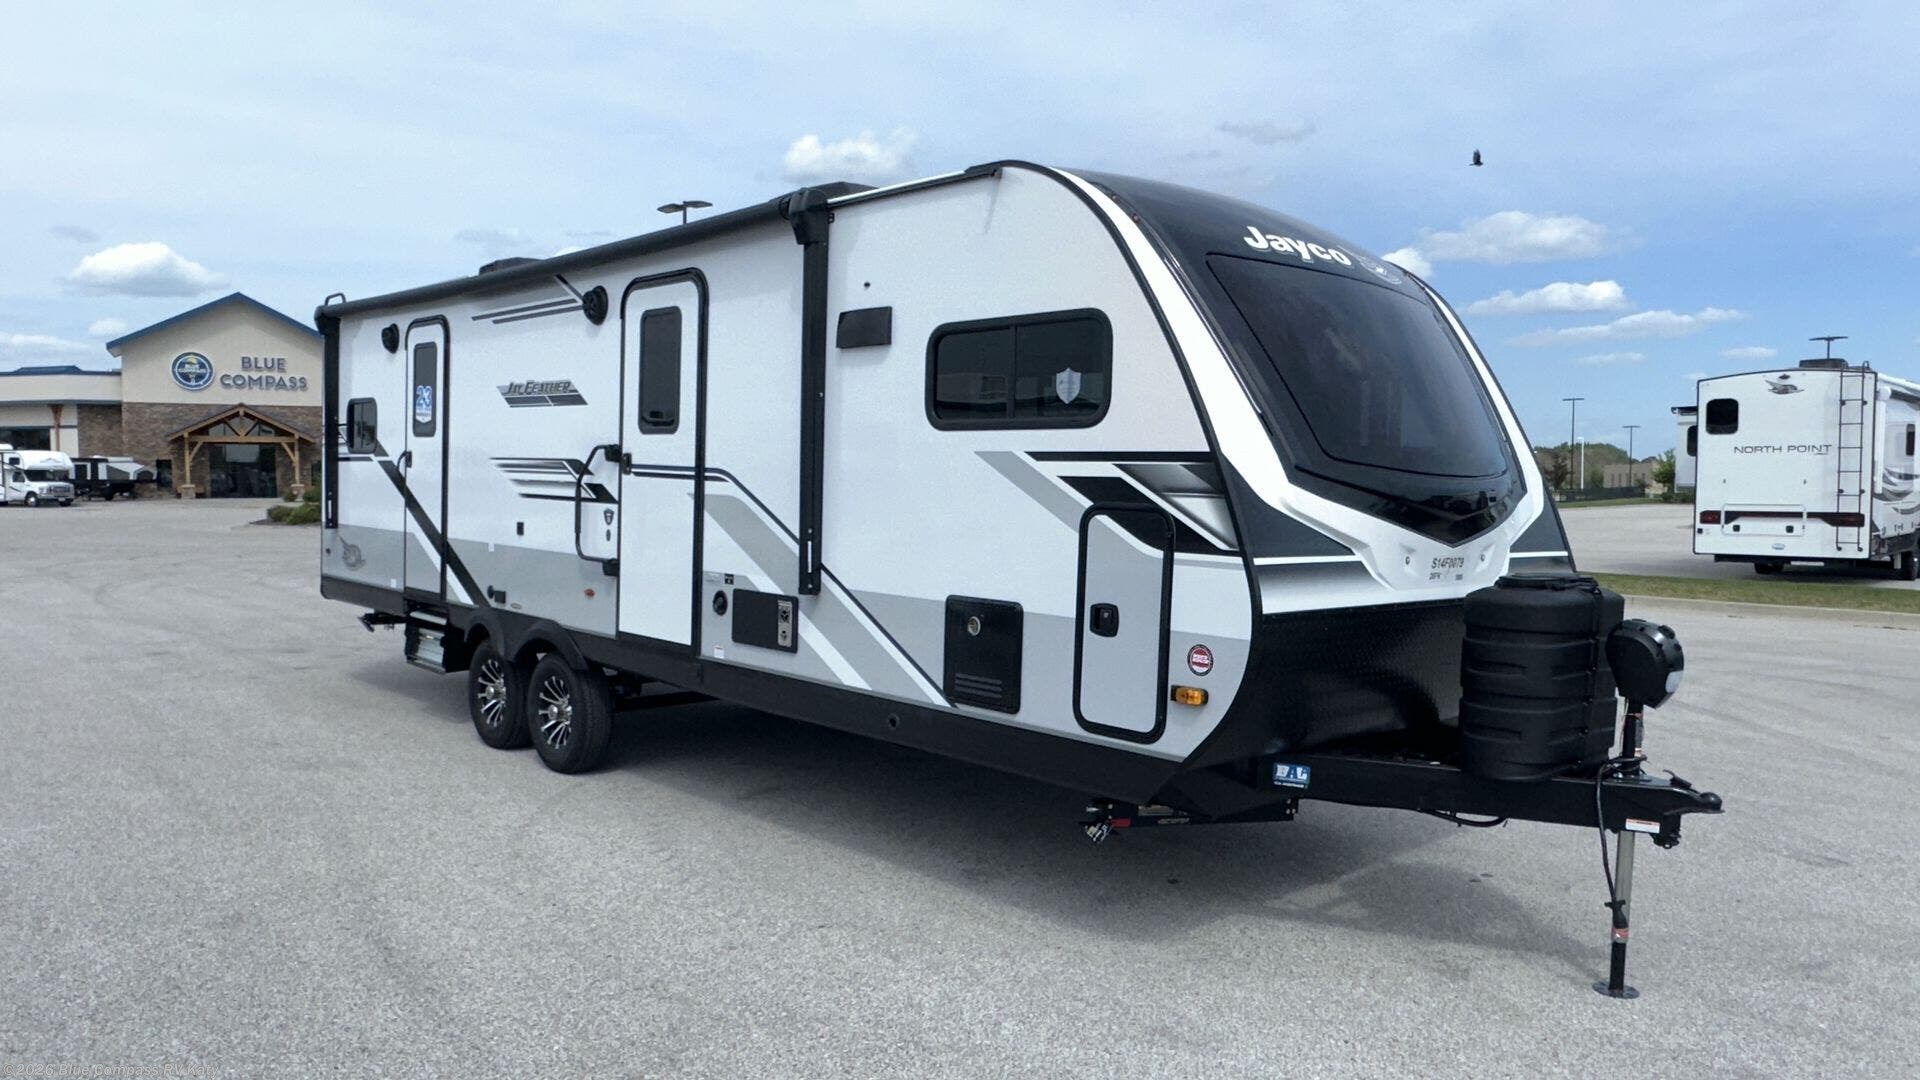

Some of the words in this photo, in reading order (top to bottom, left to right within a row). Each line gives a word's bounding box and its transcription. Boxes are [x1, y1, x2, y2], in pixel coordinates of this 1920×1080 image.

[1243, 225, 1353, 266] Jayco
[241, 356, 287, 372] BLUE
[220, 374, 308, 390] COMPASS
[1734, 445, 1783, 454] NORTH
[1787, 443, 1833, 453] POINT
